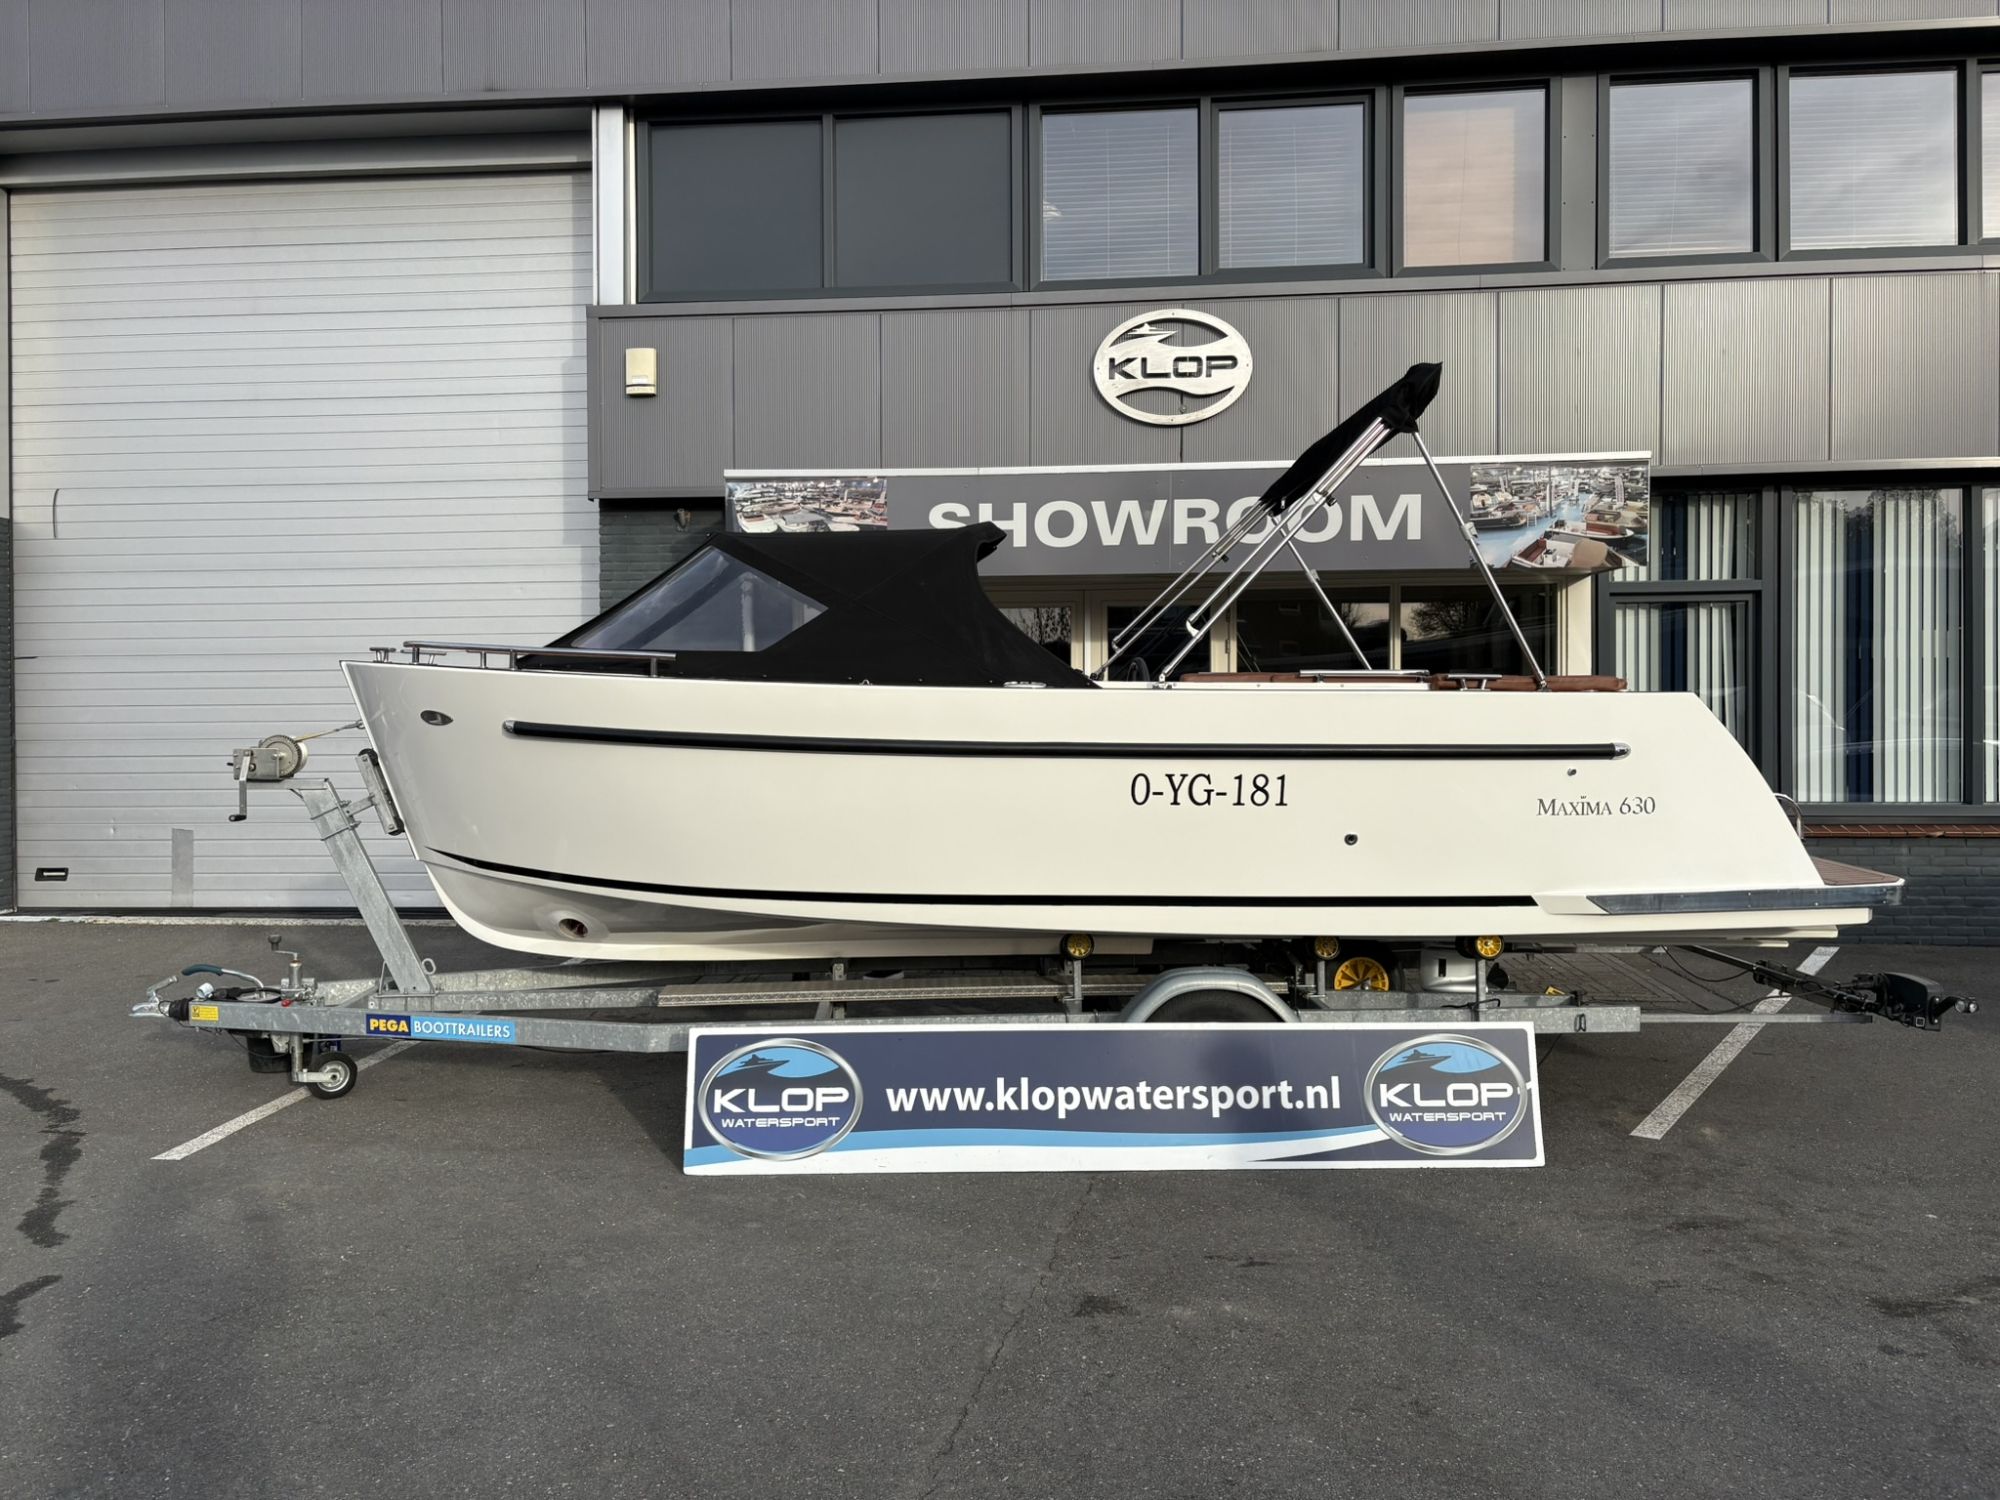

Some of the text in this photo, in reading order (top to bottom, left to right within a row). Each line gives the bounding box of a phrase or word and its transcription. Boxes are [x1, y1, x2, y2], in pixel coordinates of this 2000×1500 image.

[1108, 355, 1239, 380] KLOP
[1619, 796, 1656, 815] 630
[369, 1018, 511, 1038] PEGA BOOTTRAILERS
[713, 1087, 850, 1114] KLOP
[885, 1075, 1341, 1119] www.klopwatersport.nl
[1379, 1082, 1514, 1108] KLOP
[721, 1116, 841, 1128] WATERSPORT
[1389, 1111, 1507, 1122] WATERSPORT
